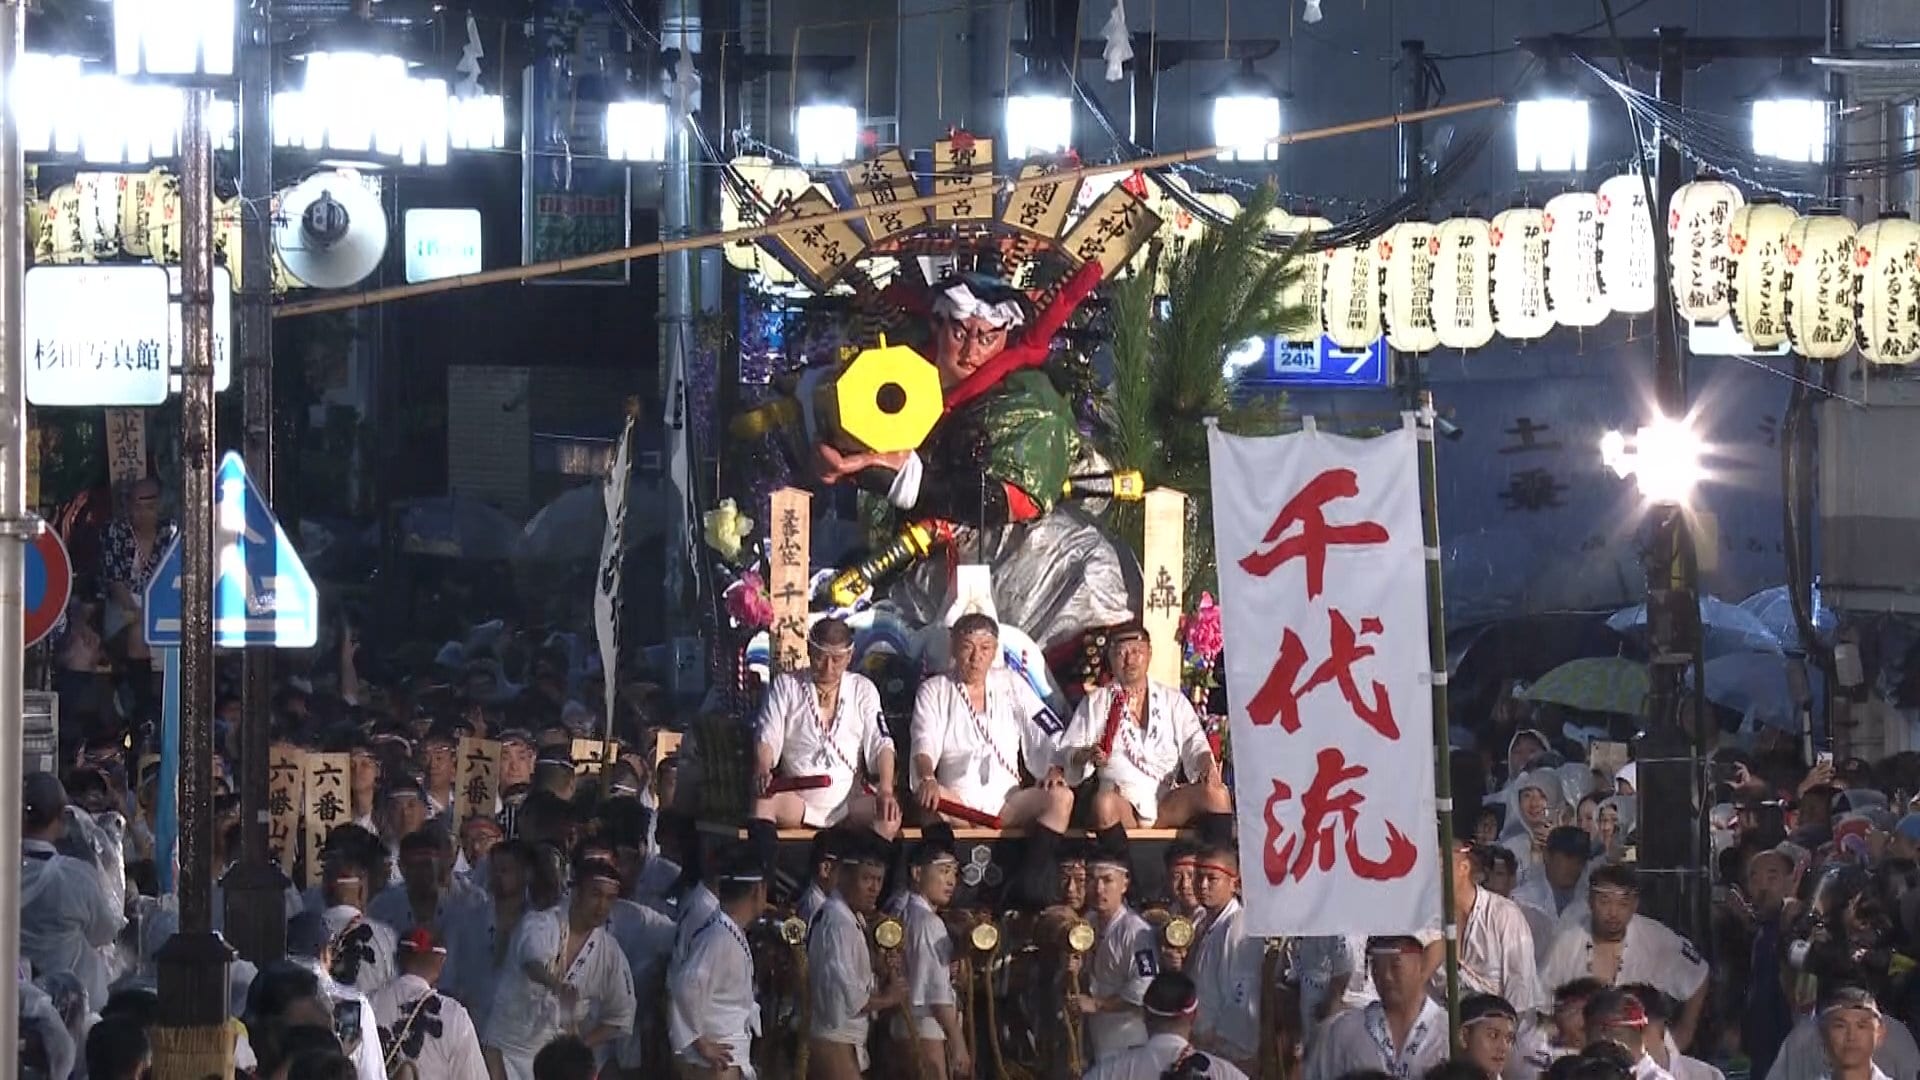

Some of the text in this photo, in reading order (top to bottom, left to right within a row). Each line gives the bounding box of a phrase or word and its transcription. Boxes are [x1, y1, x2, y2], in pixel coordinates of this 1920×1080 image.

[1688, 211, 1707, 309] ふるさと館
[1754, 241, 1777, 335] ふるさと館
[1812, 249, 1834, 343] ふるさと館
[1880, 256, 1903, 357] ふるさと館
[34, 337, 161, 372] 杉田写真館
[1280, 352, 1315, 367] 24h
[1145, 564, 1181, 620] 轟
[1237, 467, 1418, 888] 千代流
[268, 756, 298, 852] 六番山
[460, 747, 493, 816] 六番
